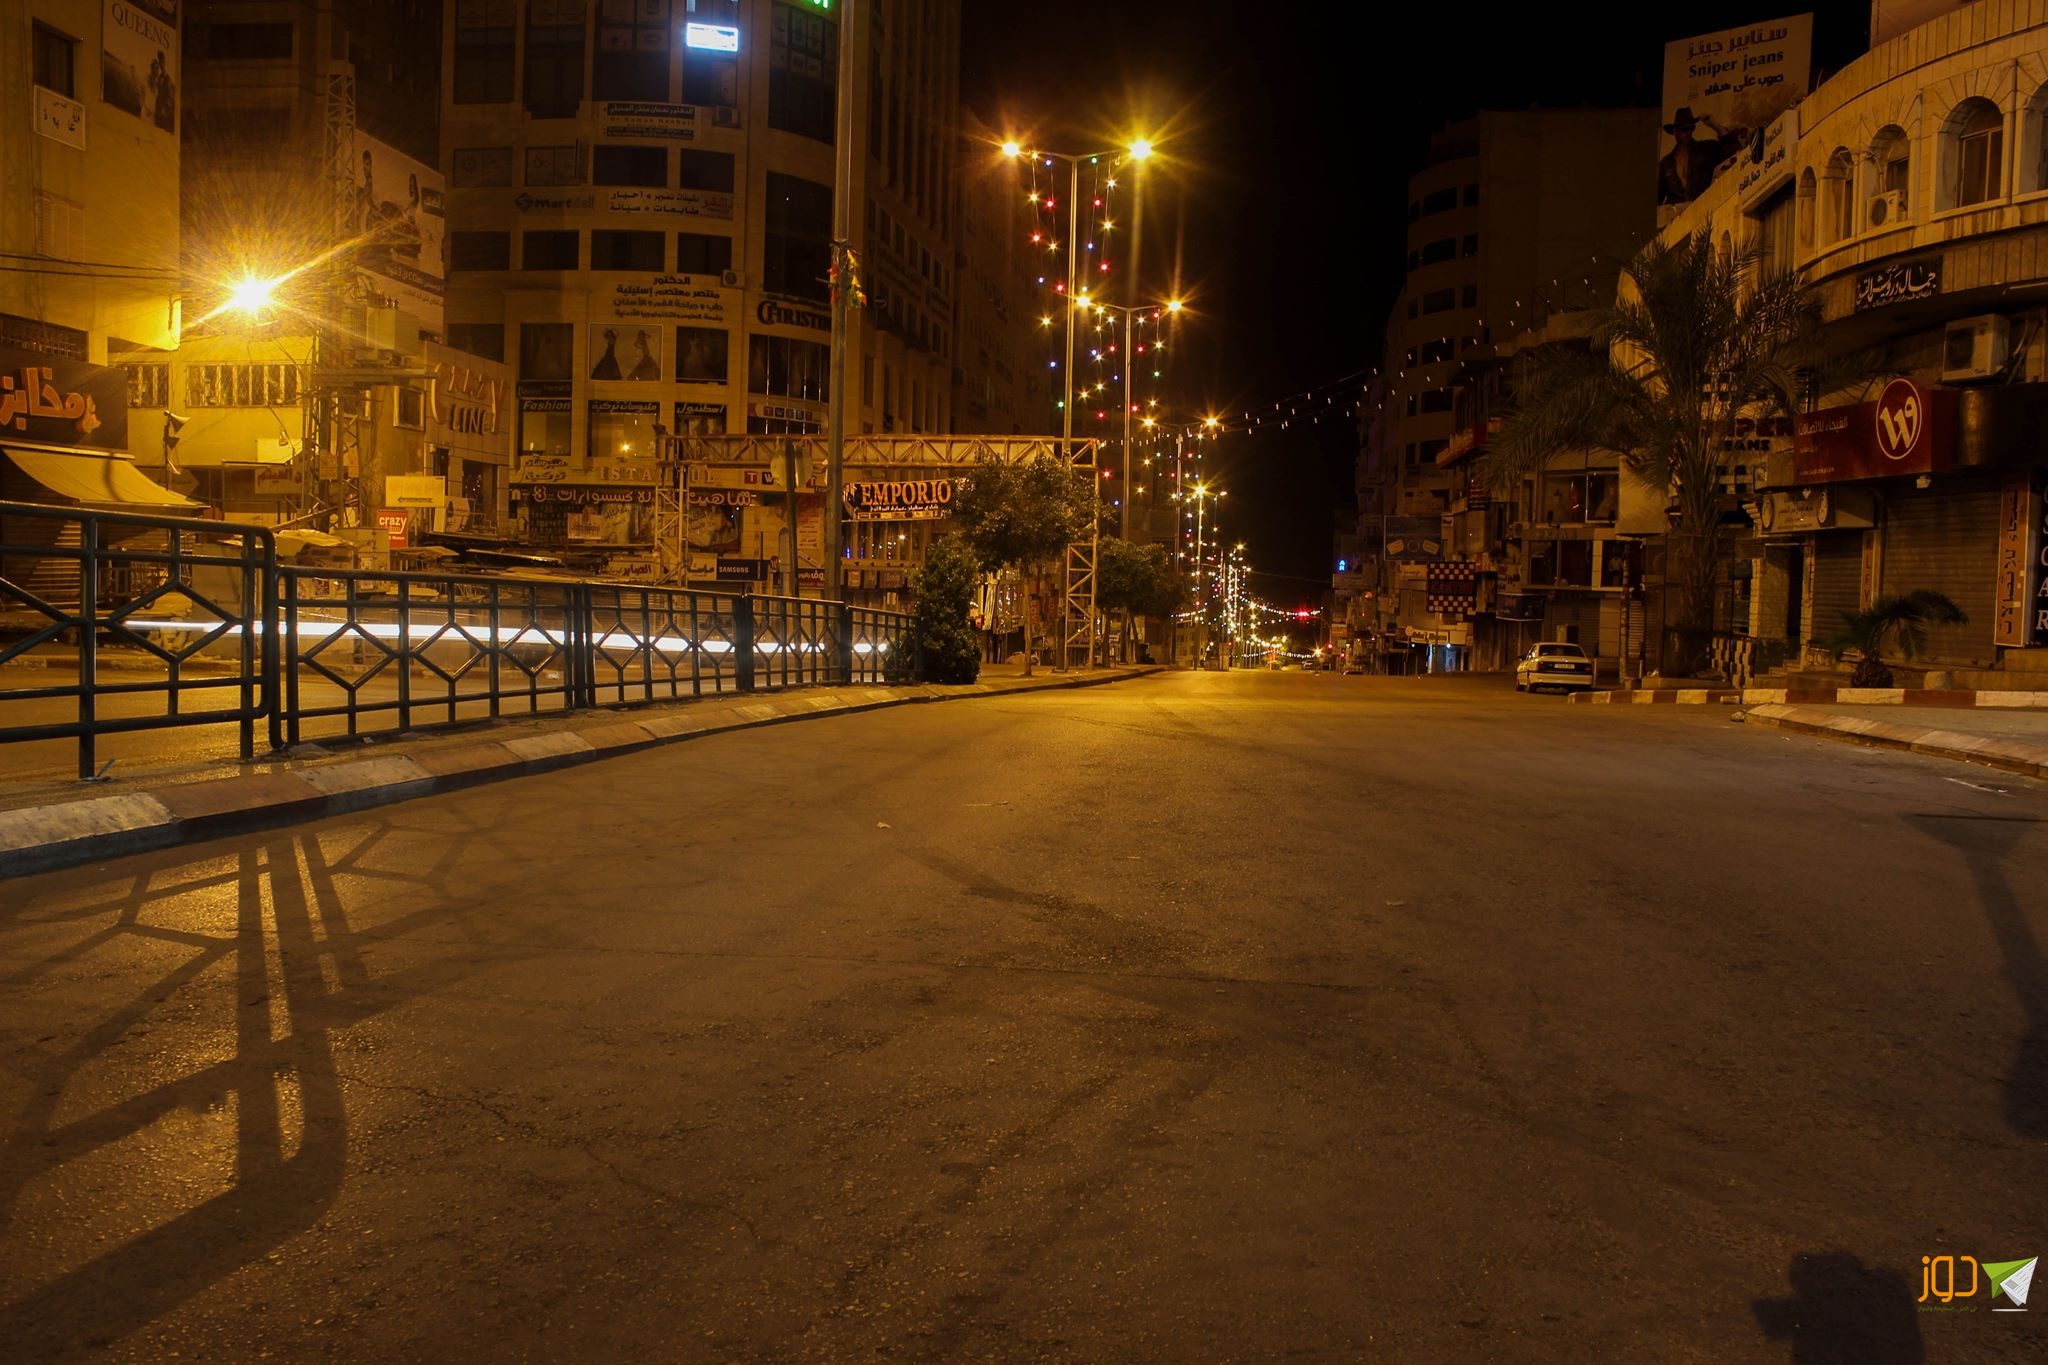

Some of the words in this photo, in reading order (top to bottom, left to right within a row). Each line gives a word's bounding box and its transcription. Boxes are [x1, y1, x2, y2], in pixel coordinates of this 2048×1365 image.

[111, 2, 170, 49] QUEENS
[1689, 60, 1738, 78] Sniper
[1743, 51, 1784, 72] jeans
[1733, 75, 1756, 93] على
[653, 275, 691, 286] الدكتور
[522, 400, 572, 411] Fashion
[860, 480, 952, 506] EMPORIO
[379, 516, 407, 534] crazy
[718, 565, 749, 574] SAMSUNG
